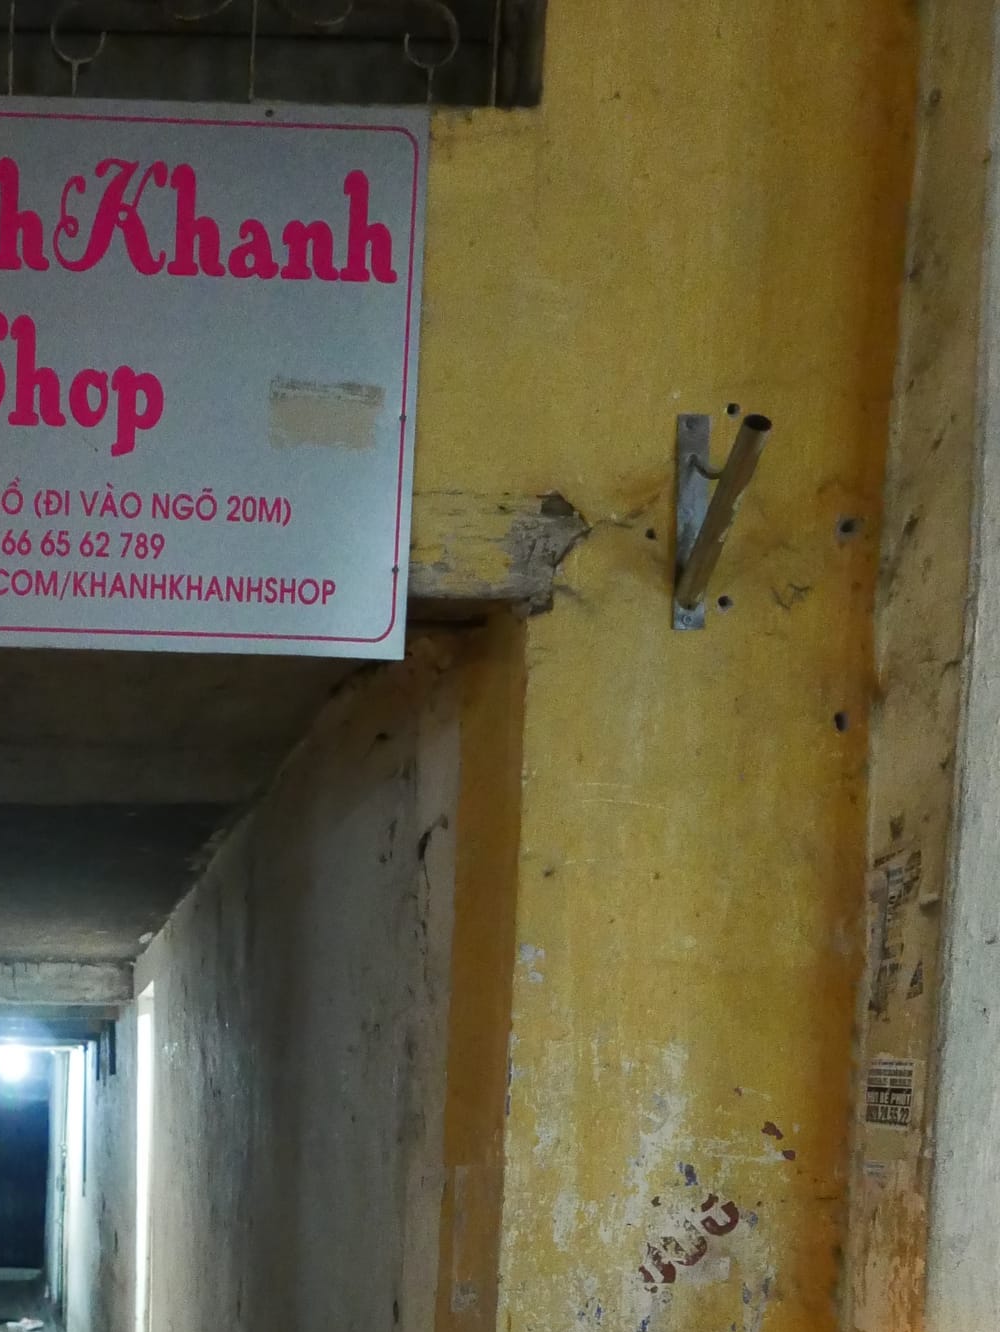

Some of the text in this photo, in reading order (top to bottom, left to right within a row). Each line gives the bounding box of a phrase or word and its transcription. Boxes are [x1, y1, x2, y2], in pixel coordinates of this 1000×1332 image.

[34, 489, 70, 518] (ĐI
[81, 482, 142, 519] VÀO
[152, 488, 218, 521] NGÕ
[227, 495, 292, 526] 20M)
[40, 531, 70, 557] 65
[79, 532, 109, 558] 62
[121, 533, 165, 559] 789
